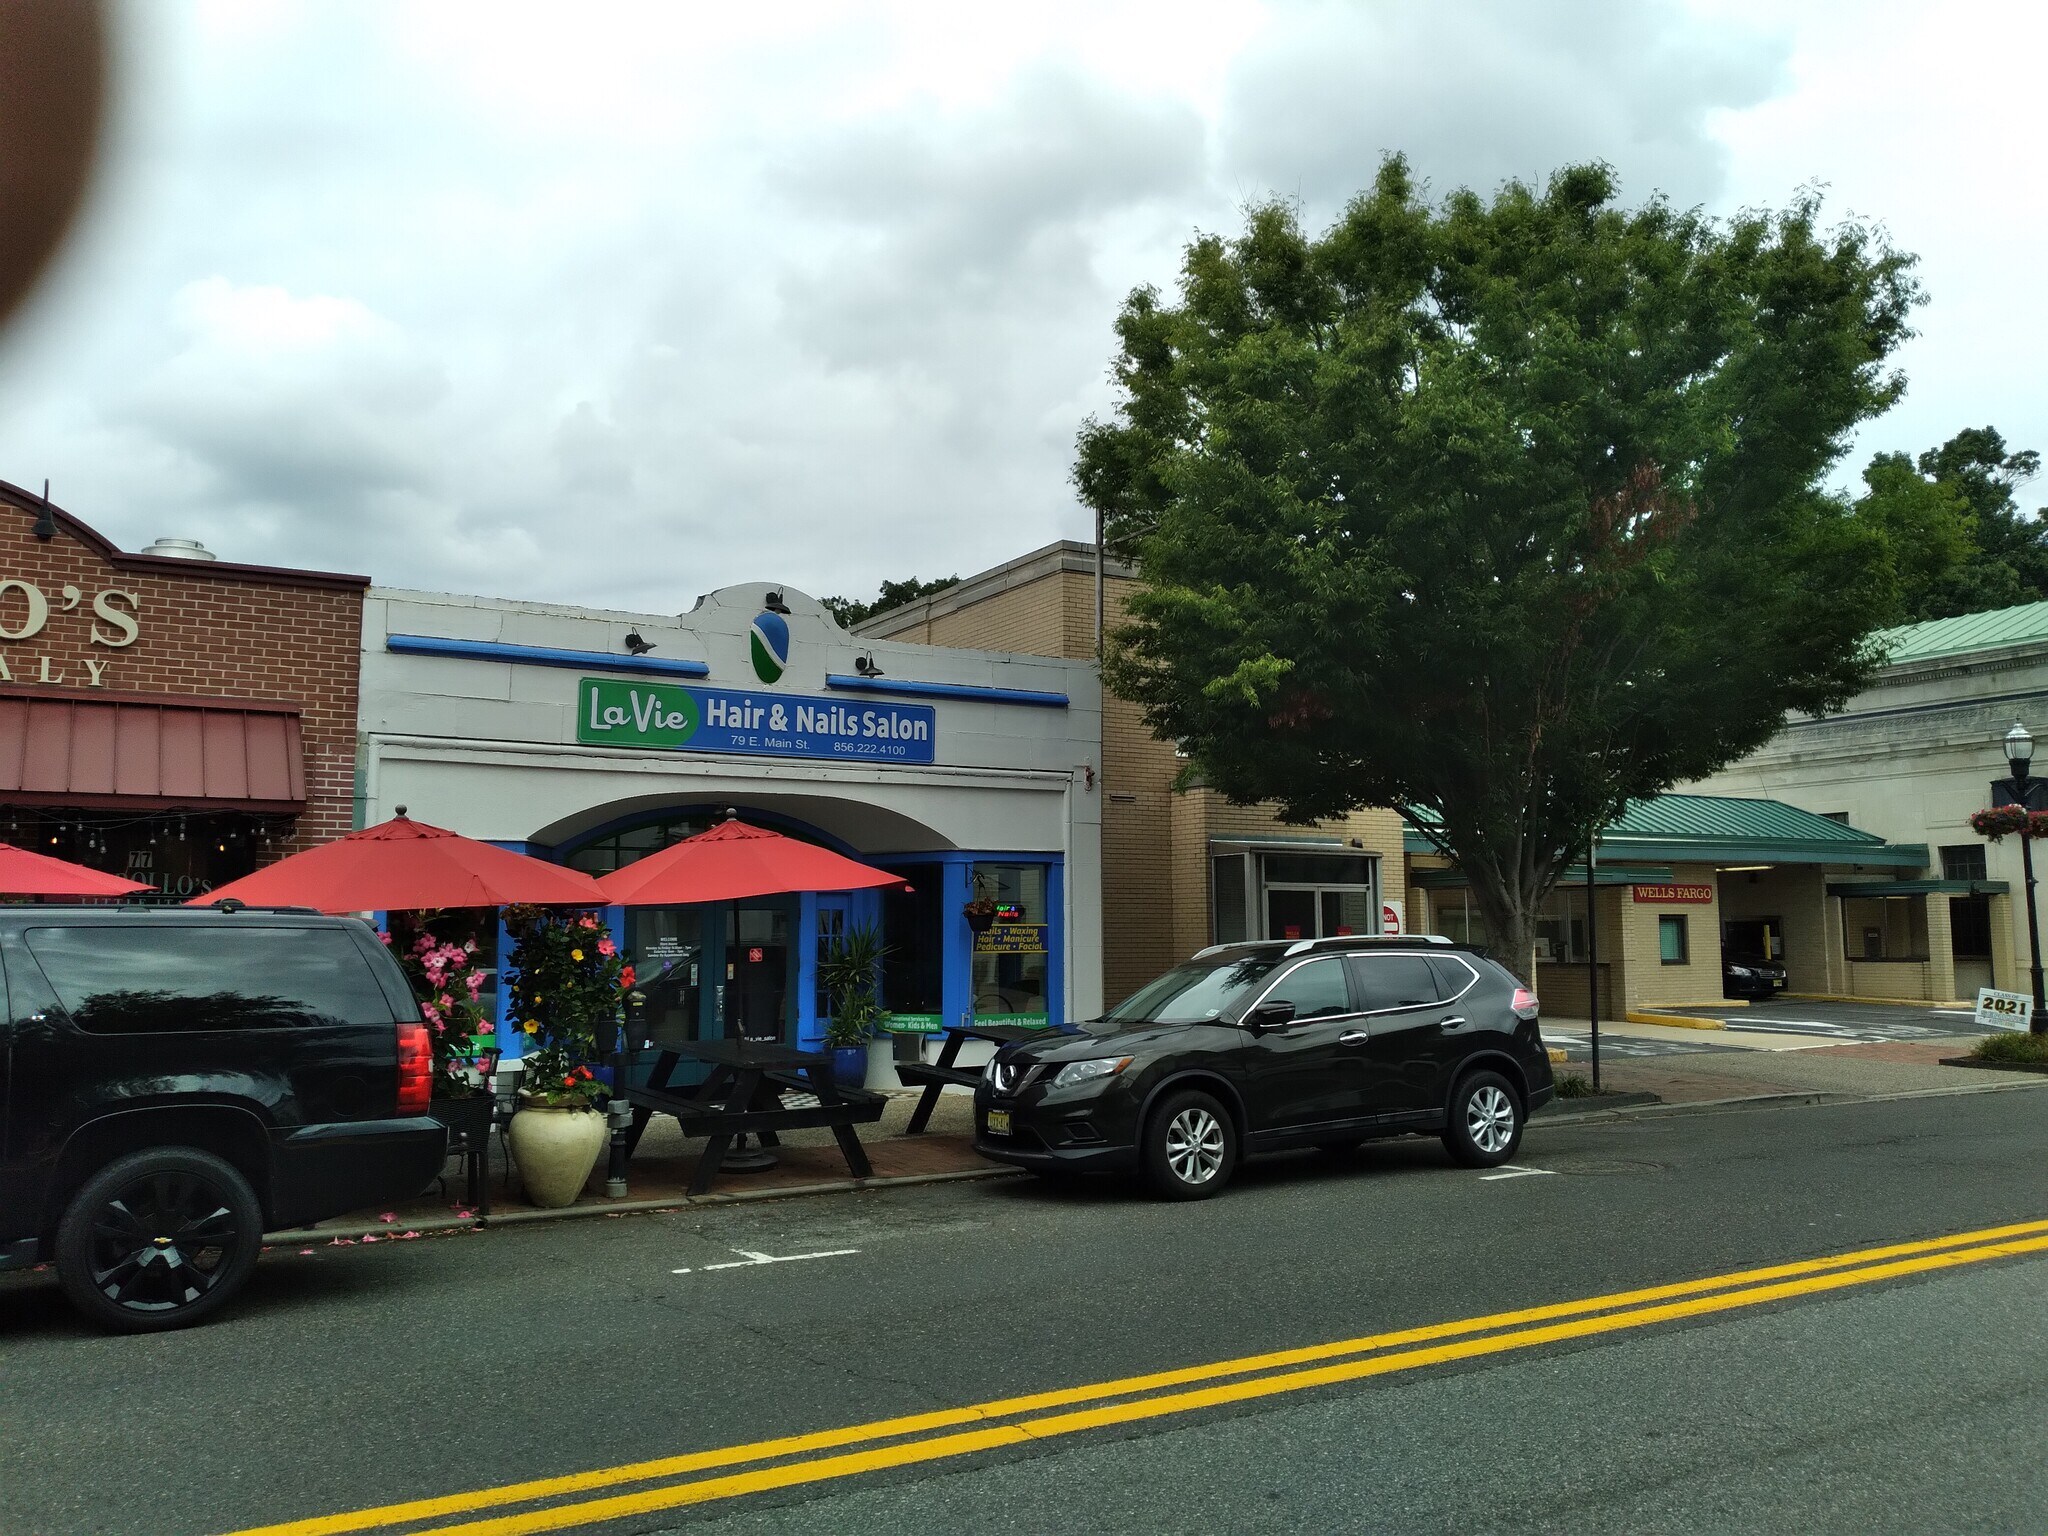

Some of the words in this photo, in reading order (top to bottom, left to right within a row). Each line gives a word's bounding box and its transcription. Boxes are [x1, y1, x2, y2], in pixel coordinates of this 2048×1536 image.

[707, 698, 765, 730] Hair
[769, 703, 788, 732] &
[796, 705, 858, 737] Nails
[863, 711, 928, 741] Salon
[731, 735, 746, 746] 79
[749, 736, 761, 747] E.
[764, 737, 792, 748] Main
[795, 739, 810, 750] St.
[833, 742, 906, 756] 856.222.4100
[130, 852, 152, 867] 77
[1637, 887, 1675, 898] WELLS
[1677, 888, 1712, 899] FARGO
[1009, 926, 1039, 937] Waxing
[977, 935, 996, 943] Hair
[1003, 935, 1040, 943] Manicure
[976, 943, 1011, 951] Pedicure
[1018, 942, 1043, 950] Facial
[1982, 996, 2026, 1016] 2021
[907, 1021, 920, 1029] Kids
[926, 1022, 938, 1030] Men
[974, 1019, 988, 1027] Feel
[988, 1018, 1017, 1027] Beautiful
[1017, 1017, 1023, 1026] &
[1022, 1017, 1047, 1026] Relaxed
